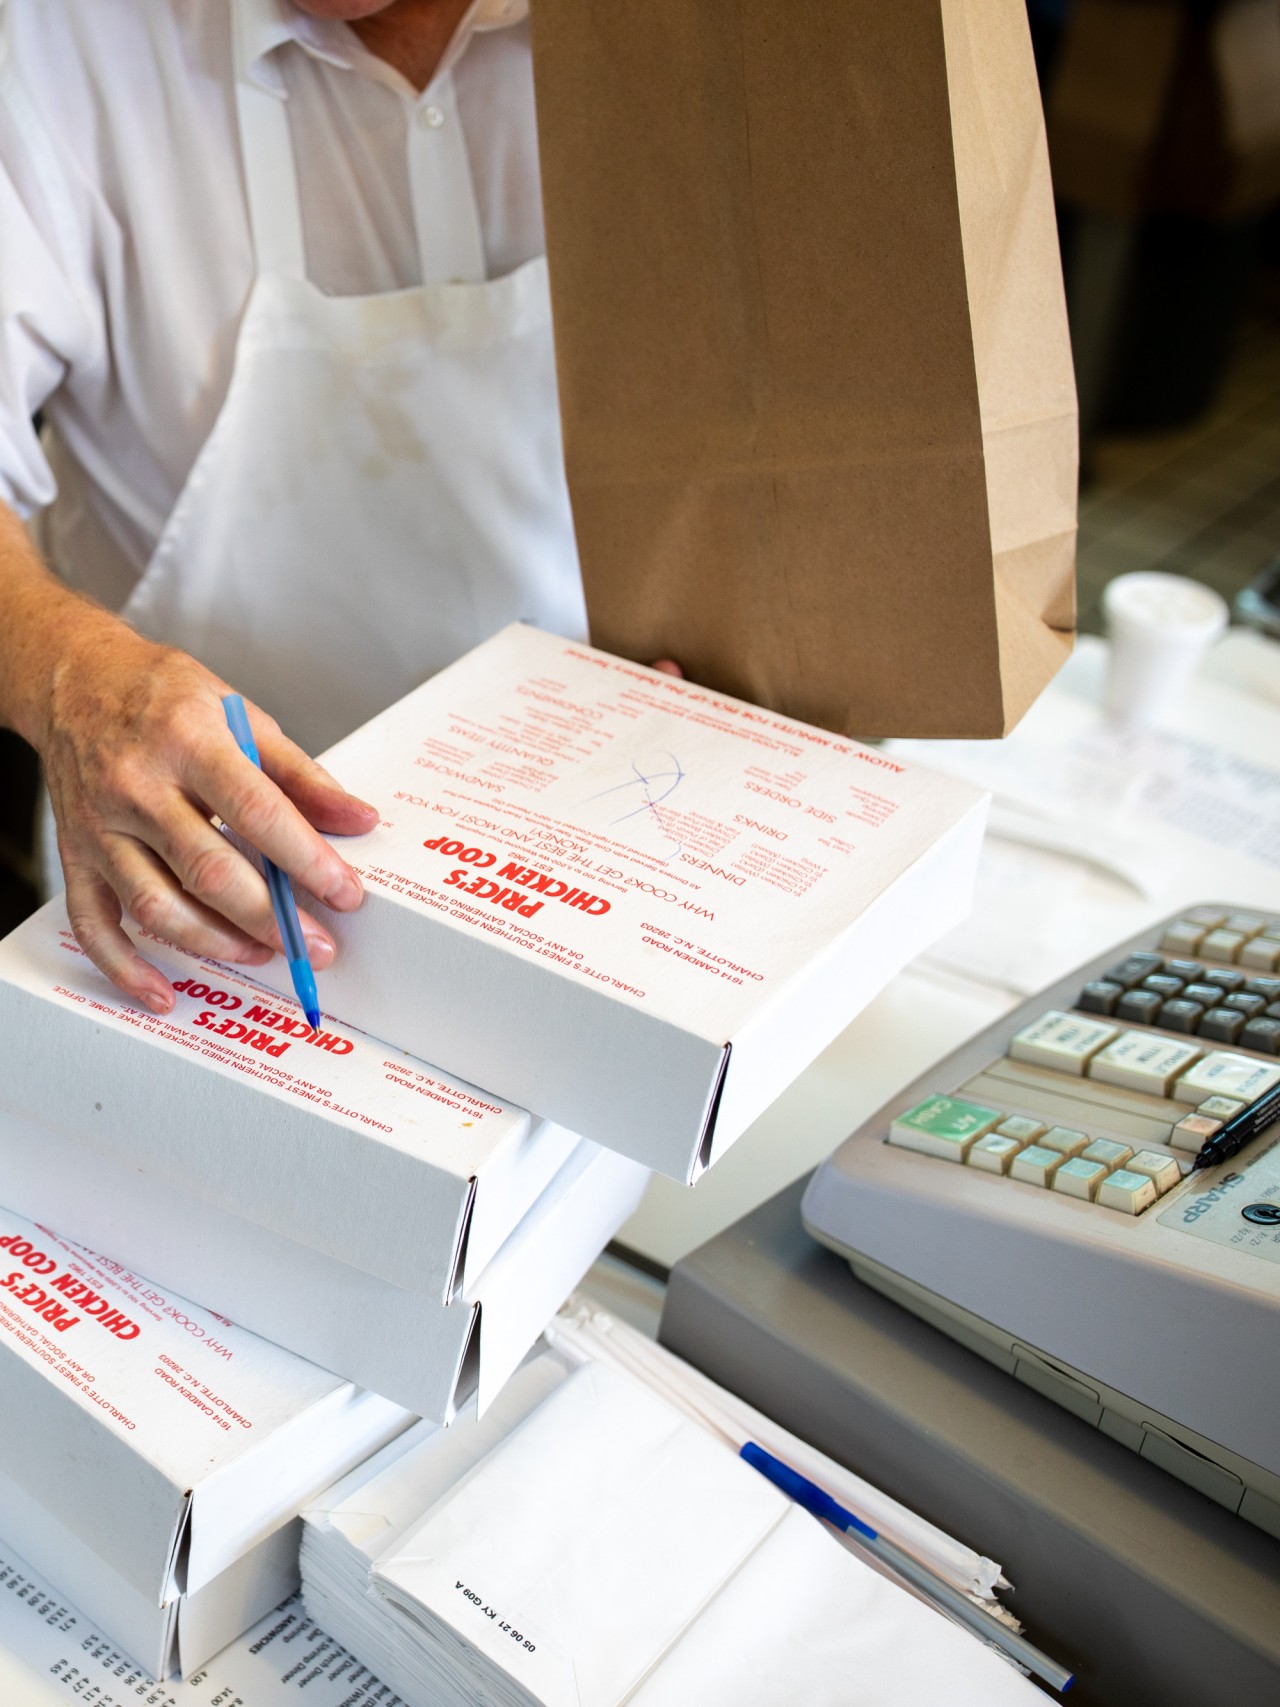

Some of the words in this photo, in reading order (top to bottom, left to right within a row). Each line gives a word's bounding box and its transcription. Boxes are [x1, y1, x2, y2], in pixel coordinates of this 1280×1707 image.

[853, 751, 905, 773] ALLOW
[415, 757, 504, 793] SANDWICHES
[393, 790, 430, 808] YOUR
[744, 781, 802, 808] ORDERS
[431, 803, 460, 818] FOR
[803, 805, 837, 824] SIDE
[458, 814, 501, 831] MOST
[732, 814, 788, 841] DRINKS
[499, 827, 534, 843] AND
[528, 828, 588, 853] MONEY!
[422, 835, 497, 869] COOP
[501, 840, 540, 856] Welcome
[507, 851, 530, 862] 1962
[532, 839, 567, 857] BEST
[531, 861, 553, 873] EST.
[567, 853, 593, 868] THE
[628, 858, 657, 872] Served
[580, 871, 597, 880] 100
[594, 864, 624, 879] GET
[655, 869, 691, 885] Dinners
[679, 853, 747, 886] DINNERS
[365, 873, 390, 887] TAKE
[385, 872, 438, 896] AVAILABLE
[390, 884, 405, 893] TO
[496, 861, 612, 916] CHICKEN
[597, 877, 629, 893] Serving
[437, 894, 449, 902] IS
[442, 869, 545, 918] PRICE'S
[623, 877, 678, 903] COOK?
[405, 890, 449, 911] CHICKEN
[449, 899, 506, 926] GATHERING
[449, 909, 480, 925] FRIED
[677, 900, 715, 921] WHY
[479, 922, 536, 949] SOUTHERN
[508, 923, 545, 943] SOCIAL
[639, 922, 671, 938] 28203
[544, 941, 568, 952] ANY
[641, 935, 673, 952] ROAD
[673, 936, 694, 949] N.C.
[535, 946, 572, 966] FINEST
[567, 950, 584, 960] OR
[672, 950, 721, 974] CAMDEN
[696, 946, 764, 981] CHARLOTTE,
[572, 962, 646, 997] CHARLOTTE'S
[720, 971, 744, 985] 1614
[51, 986, 87, 1003] OFFICE
[166, 978, 243, 1011] COOP
[252, 995, 274, 1006] 1962
[84, 1000, 117, 1016] HOME,
[276, 1004, 297, 1016] EST.
[117, 1013, 142, 1027] TAKE
[137, 1013, 189, 1037] AVAILABLE
[140, 1022, 158, 1033] TO
[188, 1034, 200, 1042] IS
[192, 1011, 292, 1057] PRICE'S
[243, 1005, 355, 1056] CHICKEN
[157, 1030, 201, 1050] CHICKEN
[200, 1039, 256, 1064] GATHERING
[200, 1048, 230, 1064] FRIED
[230, 1061, 285, 1087] SOUTHERN
[258, 1063, 294, 1081] SOCIAL
[383, 1061, 412, 1076] 28203
[294, 1078, 316, 1090] ANY
[385, 1073, 416, 1089] ROAD
[415, 1073, 435, 1086] N.C.
[286, 1084, 322, 1103] FINEST
[316, 1087, 333, 1097] OR
[415, 1086, 461, 1109] CAMDEN
[437, 1083, 502, 1114] CHARLOTTE,
[321, 1100, 393, 1133] CHARLOTTE'S
[461, 1106, 484, 1119] 1614
[1183, 1172, 1245, 1223] SHARP
[68, 1262, 86, 1276] 1962
[85, 1276, 104, 1290] EST.
[121, 1273, 143, 1290] THE
[137, 1288, 166, 1306] GET
[49, 1273, 141, 1341] CHICKEN
[162, 1306, 206, 1337] COOK?
[13, 1330, 56, 1364] SOUTHERN
[39, 1335, 67, 1359] SOCIAL
[202, 1337, 234, 1360] WHY
[64, 1358, 85, 1372] ANY
[158, 1354, 183, 1373] 28203
[54, 1363, 83, 1386] FINEST
[80, 1371, 96, 1382] OR
[153, 1367, 179, 1387] ROAD
[182, 1372, 201, 1387] N.C.
[81, 1385, 136, 1430] CHARLOTTE'S
[177, 1386, 214, 1416] CAMDEN
[200, 1387, 252, 1429] CHARLOTTE,
[212, 1414, 232, 1430] 1614
[455, 1580, 464, 1590] A
[462, 1588, 482, 1606] G09
[481, 1605, 497, 1619] KY
[58, 1617, 77, 1631] 4.71
[498, 1620, 512, 1632] 21
[80, 1634, 99, 1650] 5.57
[248, 1613, 298, 1654] SANDWICHES
[510, 1629, 524, 1642] 06
[90, 1643, 110, 1658] 5.36
[522, 1640, 536, 1653] 05
[49, 1658, 68, 1674] 6.65
[101, 1652, 121, 1667] 3.19
[319, 1650, 344, 1668] Perch
[60, 1667, 79, 1683] 6.44
[112, 1661, 132, 1676] 3.03
[189, 1668, 208, 1686] 4.00
[280, 1662, 306, 1683] Dinner
[297, 1666, 324, 1688] Dinner
[327, 1660, 353, 1681] Dinner
[72, 1677, 90, 1693] 4.27
[123, 1670, 143, 1685] 4.06
[134, 1677, 154, 1695] 5.30
[82, 1686, 101, 1701] 4.11
[146, 1688, 165, 1704] 5.30
[210, 1686, 233, 1706] 14.00
